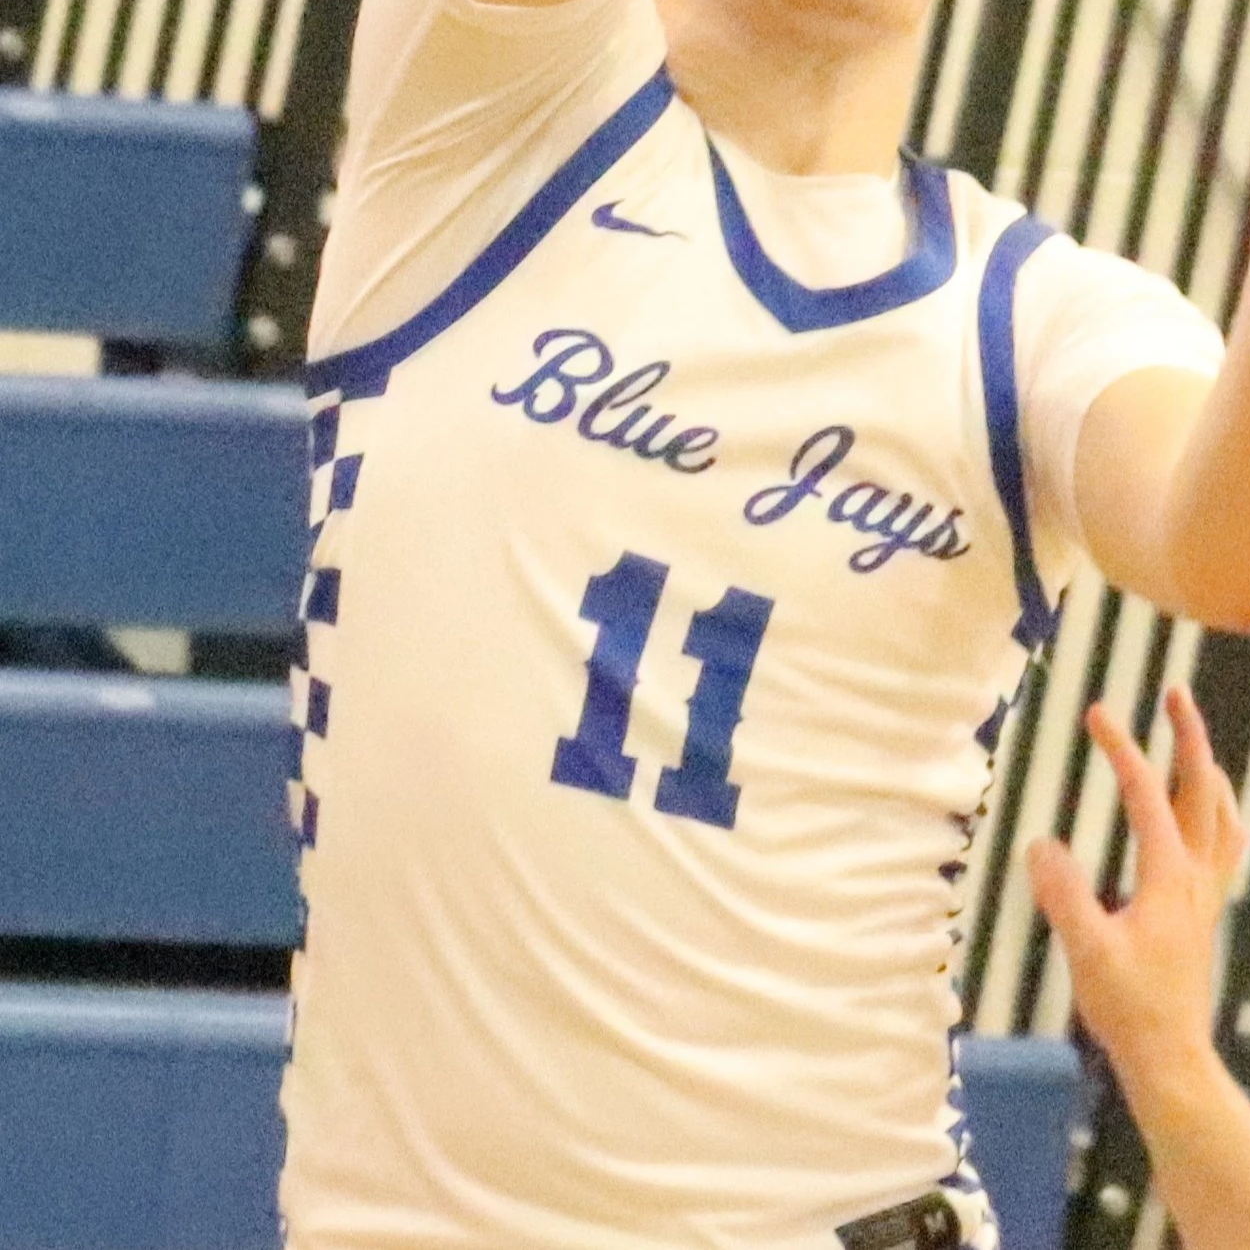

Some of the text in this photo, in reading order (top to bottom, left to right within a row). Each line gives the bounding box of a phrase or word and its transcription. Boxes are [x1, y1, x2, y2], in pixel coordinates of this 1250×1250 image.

[491, 327, 972, 574] Blue Jays
[550, 550, 775, 830] 11
